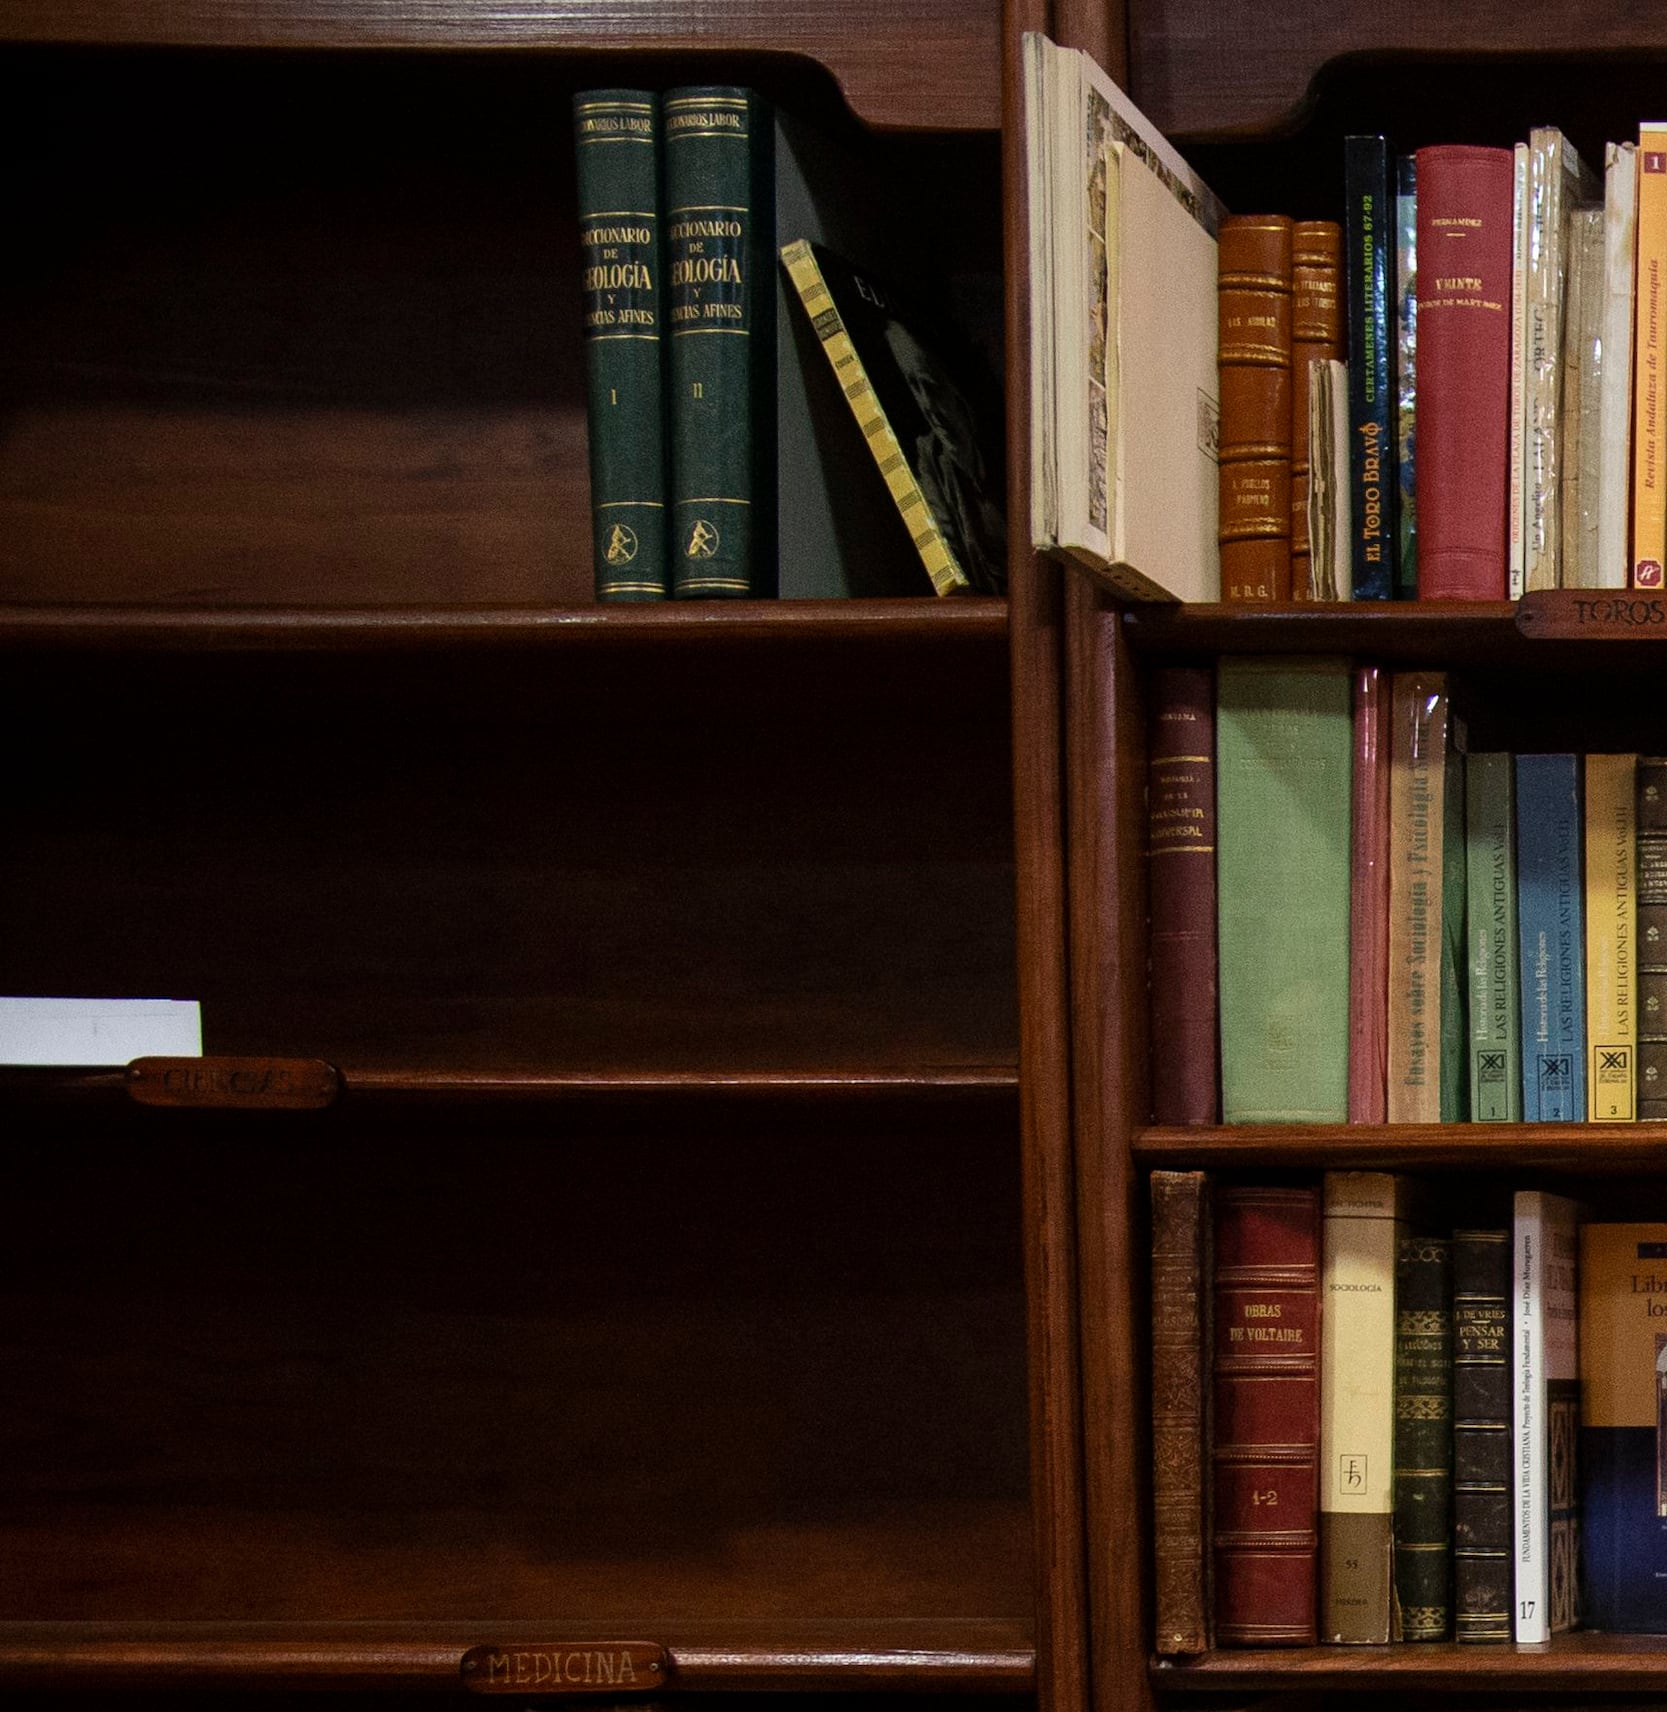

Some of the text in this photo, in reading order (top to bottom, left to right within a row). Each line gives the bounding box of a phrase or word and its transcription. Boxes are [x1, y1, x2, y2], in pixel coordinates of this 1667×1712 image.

[709, 113, 739, 127] LABOR
[603, 249, 618, 259] DE
[689, 243, 704, 254] DE
[617, 311, 654, 325] AFINES
[703, 304, 742, 319] AFINES
[1363, 234, 1375, 403] CERTAMENES LITERARIOS
[1645, 259, 1659, 490] Revista Tauromaquia
[1367, 490, 1382, 564] EL TORO
[1576, 600, 1665, 624] TOROS
[1491, 853, 1507, 1040] LAS RELIGIONES ANTIGUAS
[1558, 858, 1574, 1042] LAS RELIGIONES ANTIGUAS
[1616, 847, 1630, 1036] LAS RELIGIONES ANTIGUAS
[1244, 1305, 1282, 1319] OBRAS
[1229, 1326, 1303, 1343] DE VOLTAIRE
[1459, 1325, 1506, 1339] PENSAR
[1477, 1338, 1500, 1350] SER
[1521, 1600, 1536, 1620] 17
[486, 1649, 637, 1685] MEDICINA
